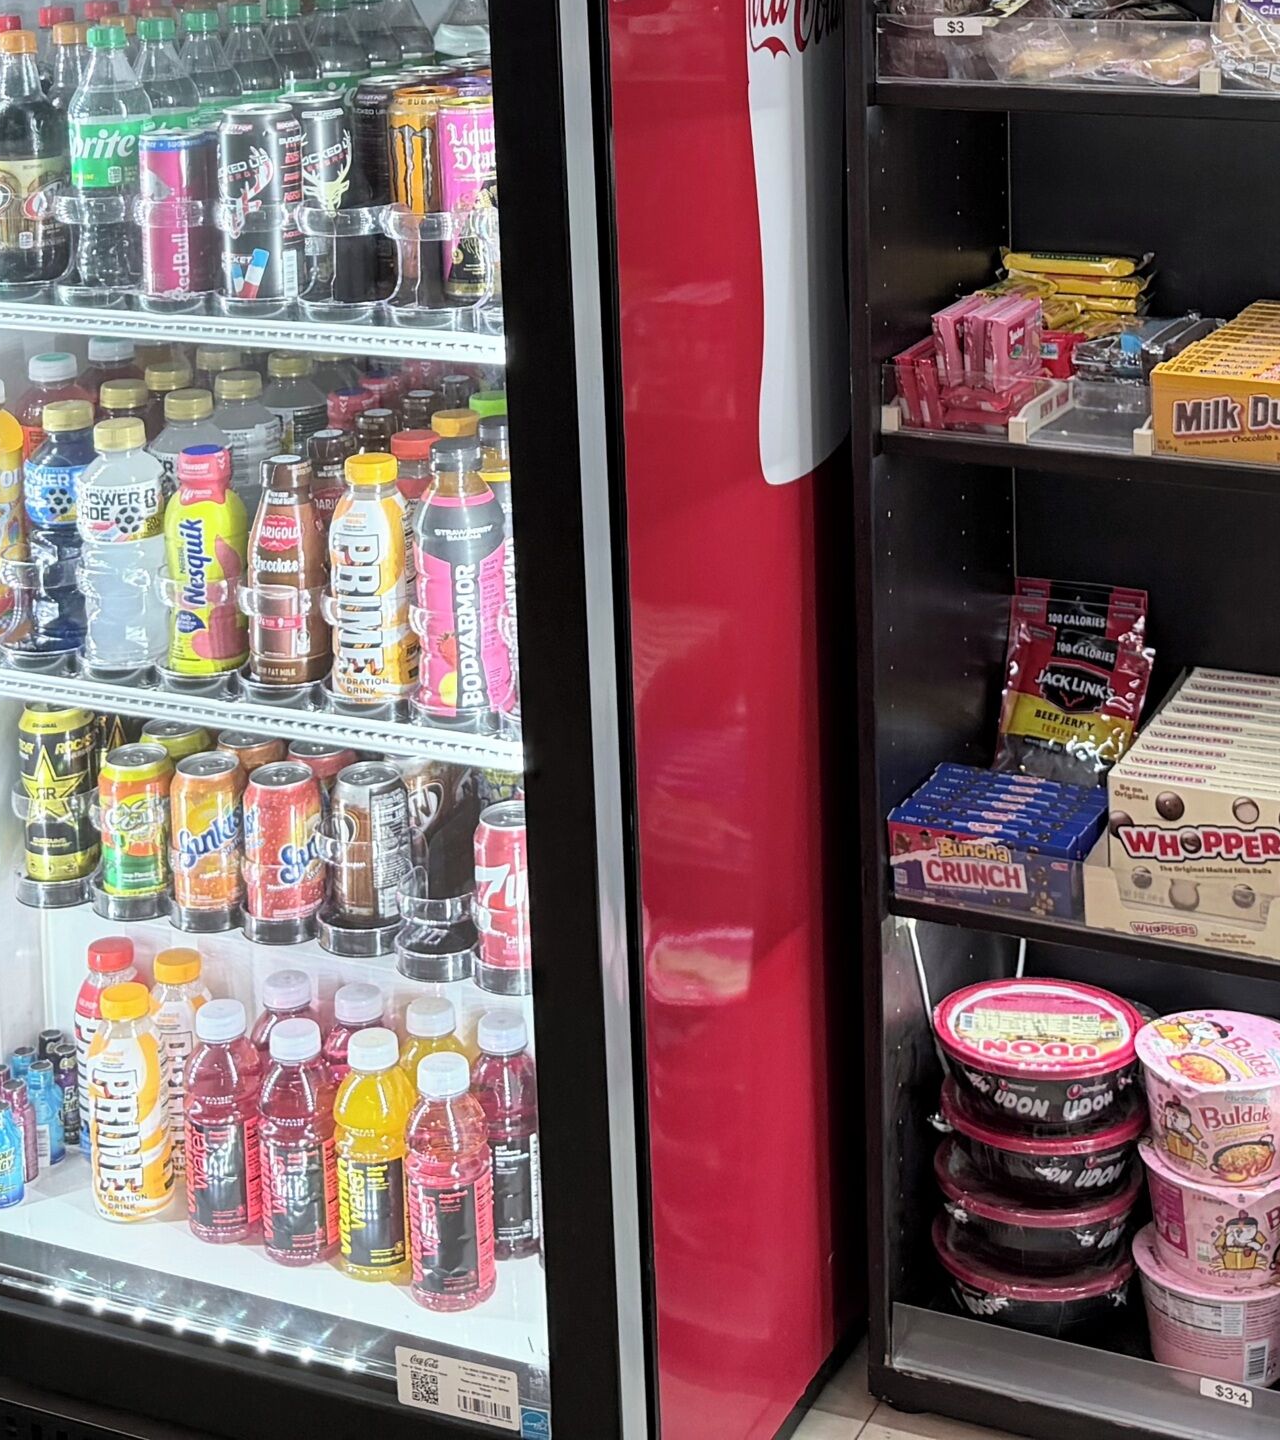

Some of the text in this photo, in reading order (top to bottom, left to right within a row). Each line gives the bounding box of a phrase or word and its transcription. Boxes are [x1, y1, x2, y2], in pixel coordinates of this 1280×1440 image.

[946, 18, 966, 36] $3
[1173, 397, 1242, 436] Milk
[1232, 434, 1272, 444] Chocolate
[182, 518, 212, 606] Nesquik
[333, 534, 385, 675] PRIME
[1048, 612, 1107, 629] 100 CALORIES
[455, 563, 484, 707] BODYARMOR
[1056, 641, 1115, 664] 100 CALORIES
[1033, 708, 1096, 732] BEEF JERKY
[937, 838, 1010, 863] Buncha
[925, 862, 1022, 890] CRUNCH
[1159, 865, 1272, 875] The Original Milk Balls
[1132, 921, 1197, 936] WHOPPERS
[993, 1088, 1050, 1118] UDON
[1062, 1090, 1114, 1120] UDON
[1198, 1105, 1272, 1129] Buldak
